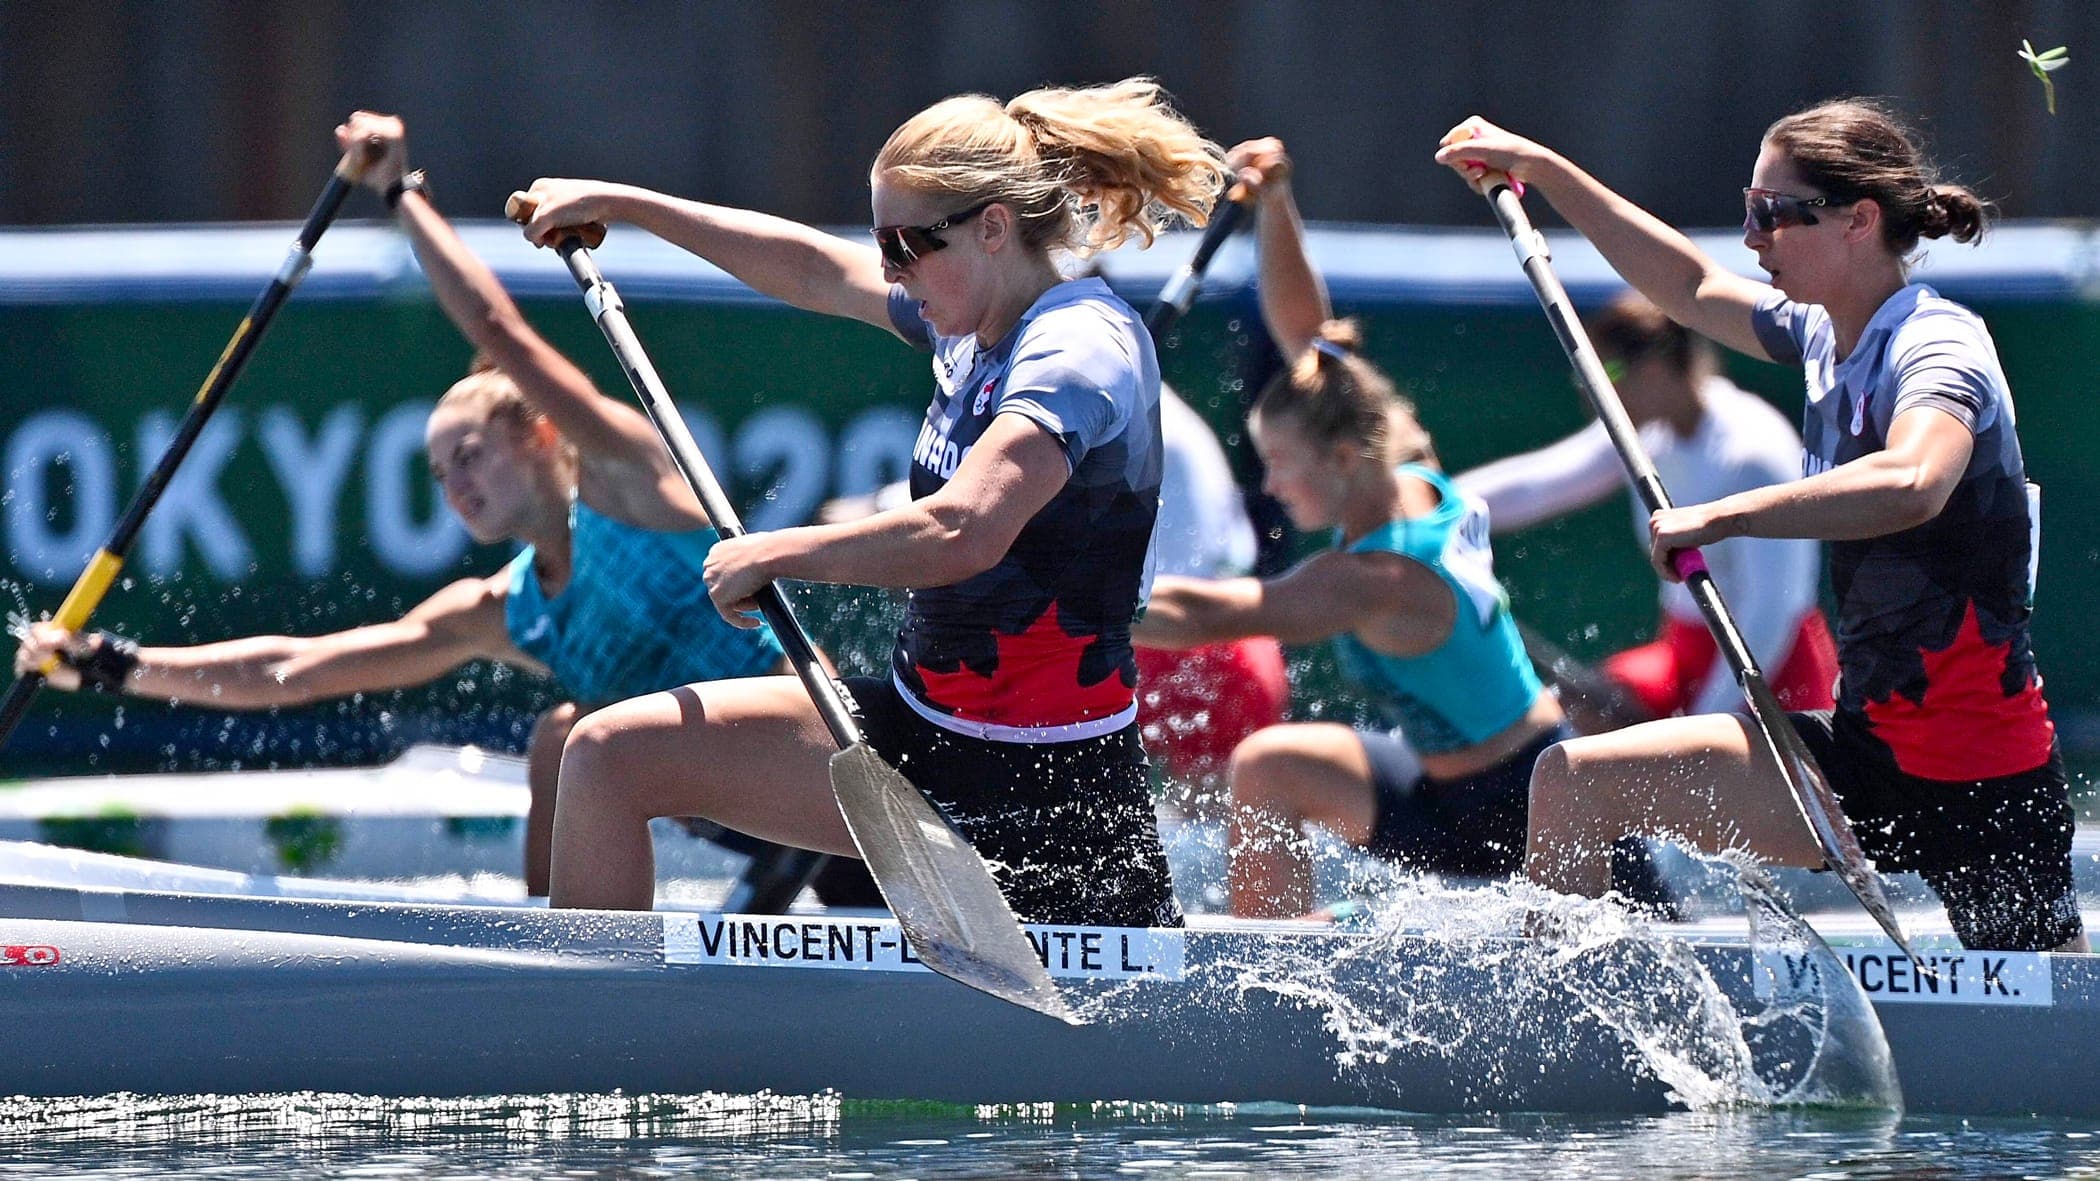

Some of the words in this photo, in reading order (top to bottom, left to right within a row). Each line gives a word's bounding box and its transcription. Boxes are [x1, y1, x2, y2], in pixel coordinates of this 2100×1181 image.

[697, 920, 1103, 971] VINCENT-LNTE
[1122, 931, 1155, 973] L.
[1983, 957, 2021, 996] K.
